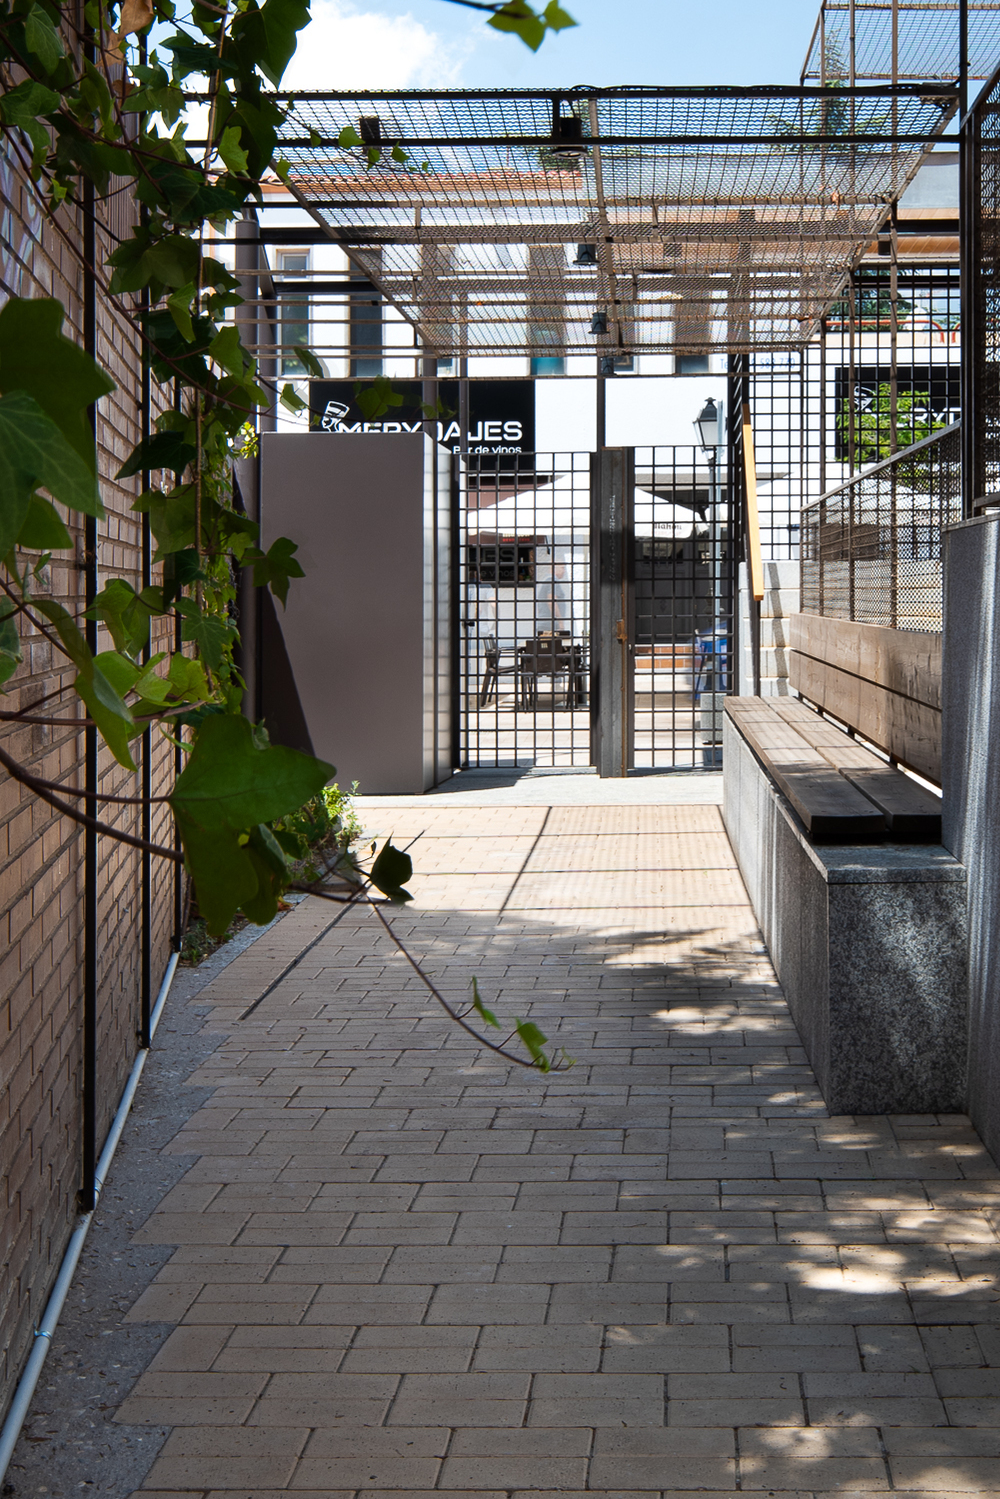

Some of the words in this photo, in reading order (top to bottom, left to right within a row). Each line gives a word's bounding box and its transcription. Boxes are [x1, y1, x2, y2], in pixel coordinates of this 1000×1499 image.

[453, 445, 473, 454] Br
[474, 445, 490, 454] de
[491, 445, 522, 454] vinos
